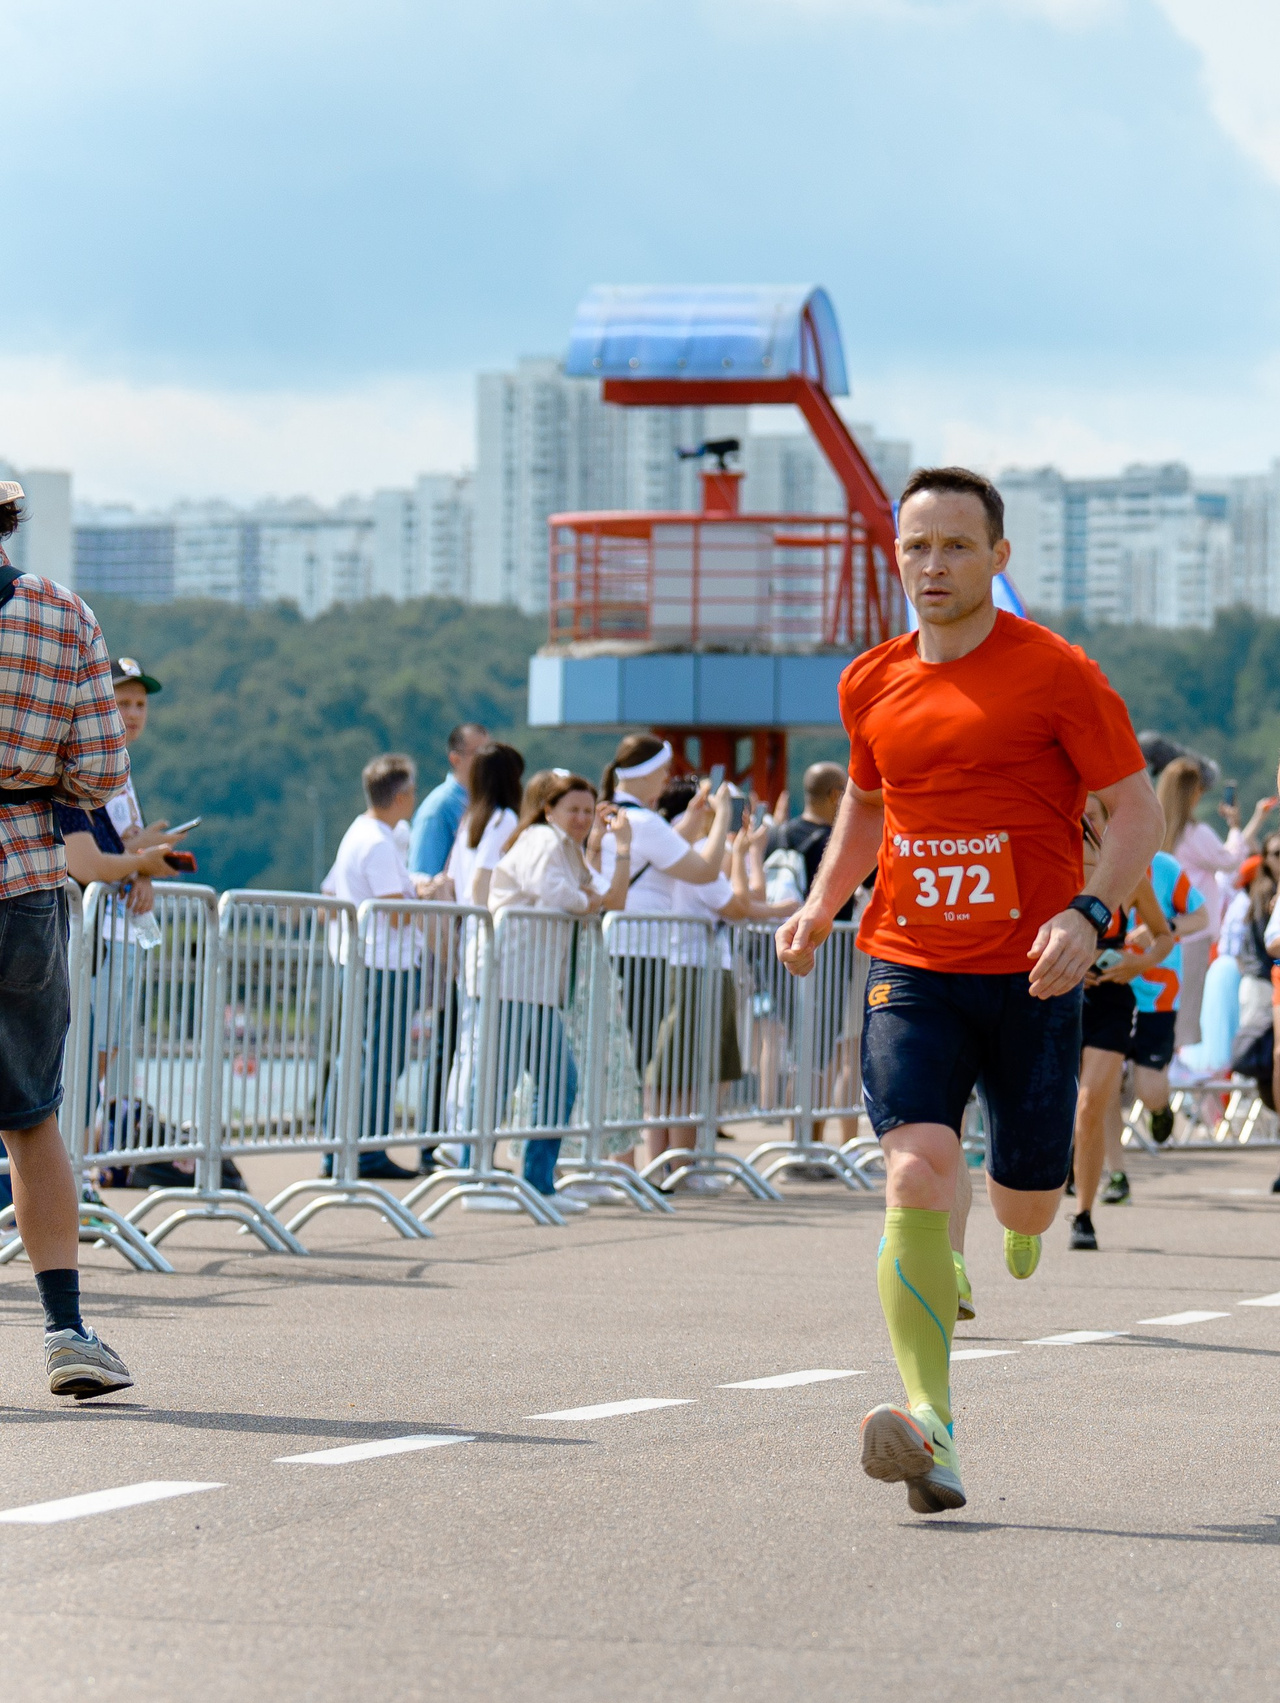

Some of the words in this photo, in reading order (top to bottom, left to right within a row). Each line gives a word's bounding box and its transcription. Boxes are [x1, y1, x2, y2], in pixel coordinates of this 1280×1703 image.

[899, 839, 910, 857] Я
[912, 840, 926, 857] С
[926, 833, 1001, 857] ТОБОЙ
[912, 864, 995, 908] 372
[943, 911, 955, 922] 10
[956, 912, 971, 921] км
